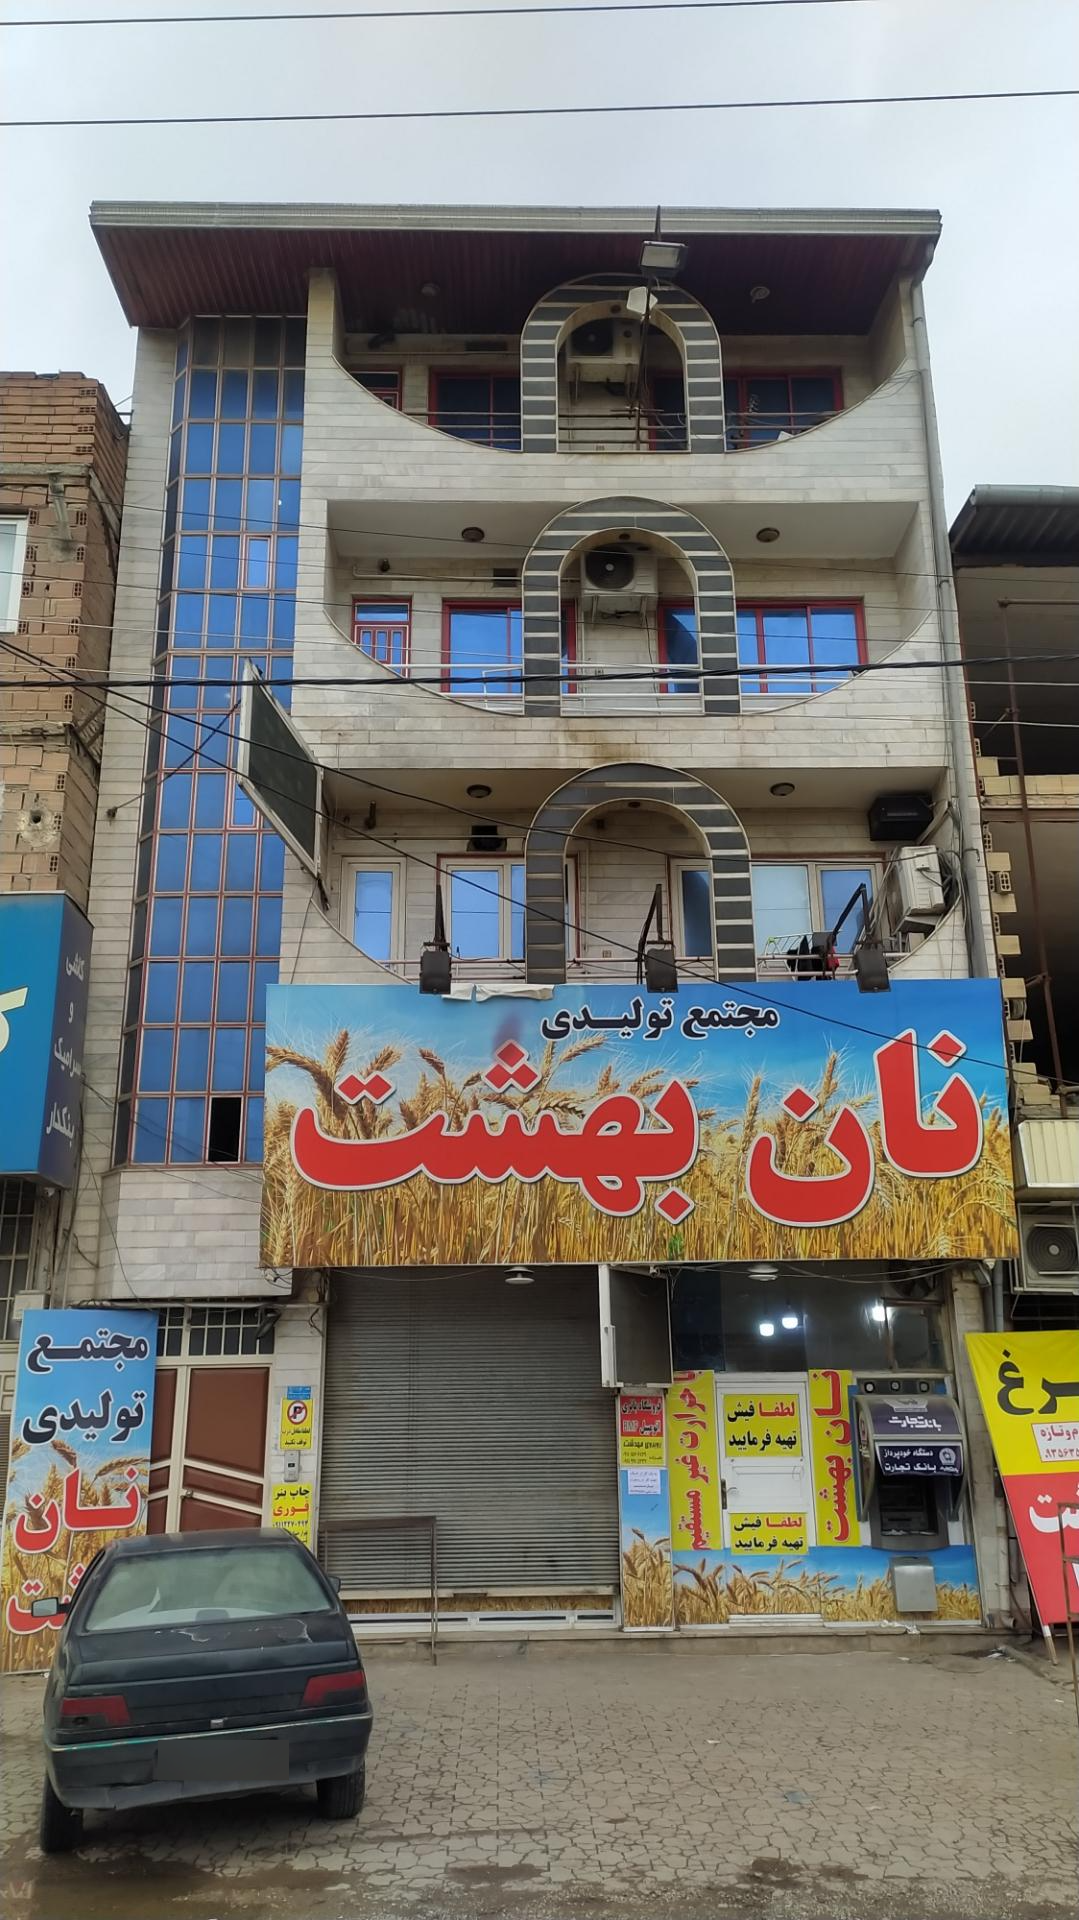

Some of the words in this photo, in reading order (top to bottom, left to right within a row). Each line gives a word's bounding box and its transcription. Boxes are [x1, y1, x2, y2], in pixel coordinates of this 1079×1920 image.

[541, 996, 674, 1040] تولیدی
[681, 1002, 780, 1040] مجتمع
[290, 1040, 701, 1226] بهشت
[745, 1027, 985, 1228] نان
[26, 1327, 151, 1374] مجتمع
[22, 1389, 145, 1446] تولیدی
[727, 1403, 756, 1424] فیش
[758, 1401, 796, 1418] لطفا
[813, 1370, 852, 1445] نان
[728, 1430, 772, 1451] فرمایید
[773, 1431, 798, 1449] تهیه
[675, 1454, 710, 1485] غیر
[14, 1464, 142, 1553] نان
[273, 1500, 310, 1517] فوری
[819, 1455, 852, 1542] بهشت
[678, 1490, 713, 1552] مستقیم
[733, 1518, 762, 1532] فیش
[765, 1516, 803, 1529] لطفا
[735, 1536, 778, 1551] فرمایید
[778, 1537, 804, 1549] تهیه
